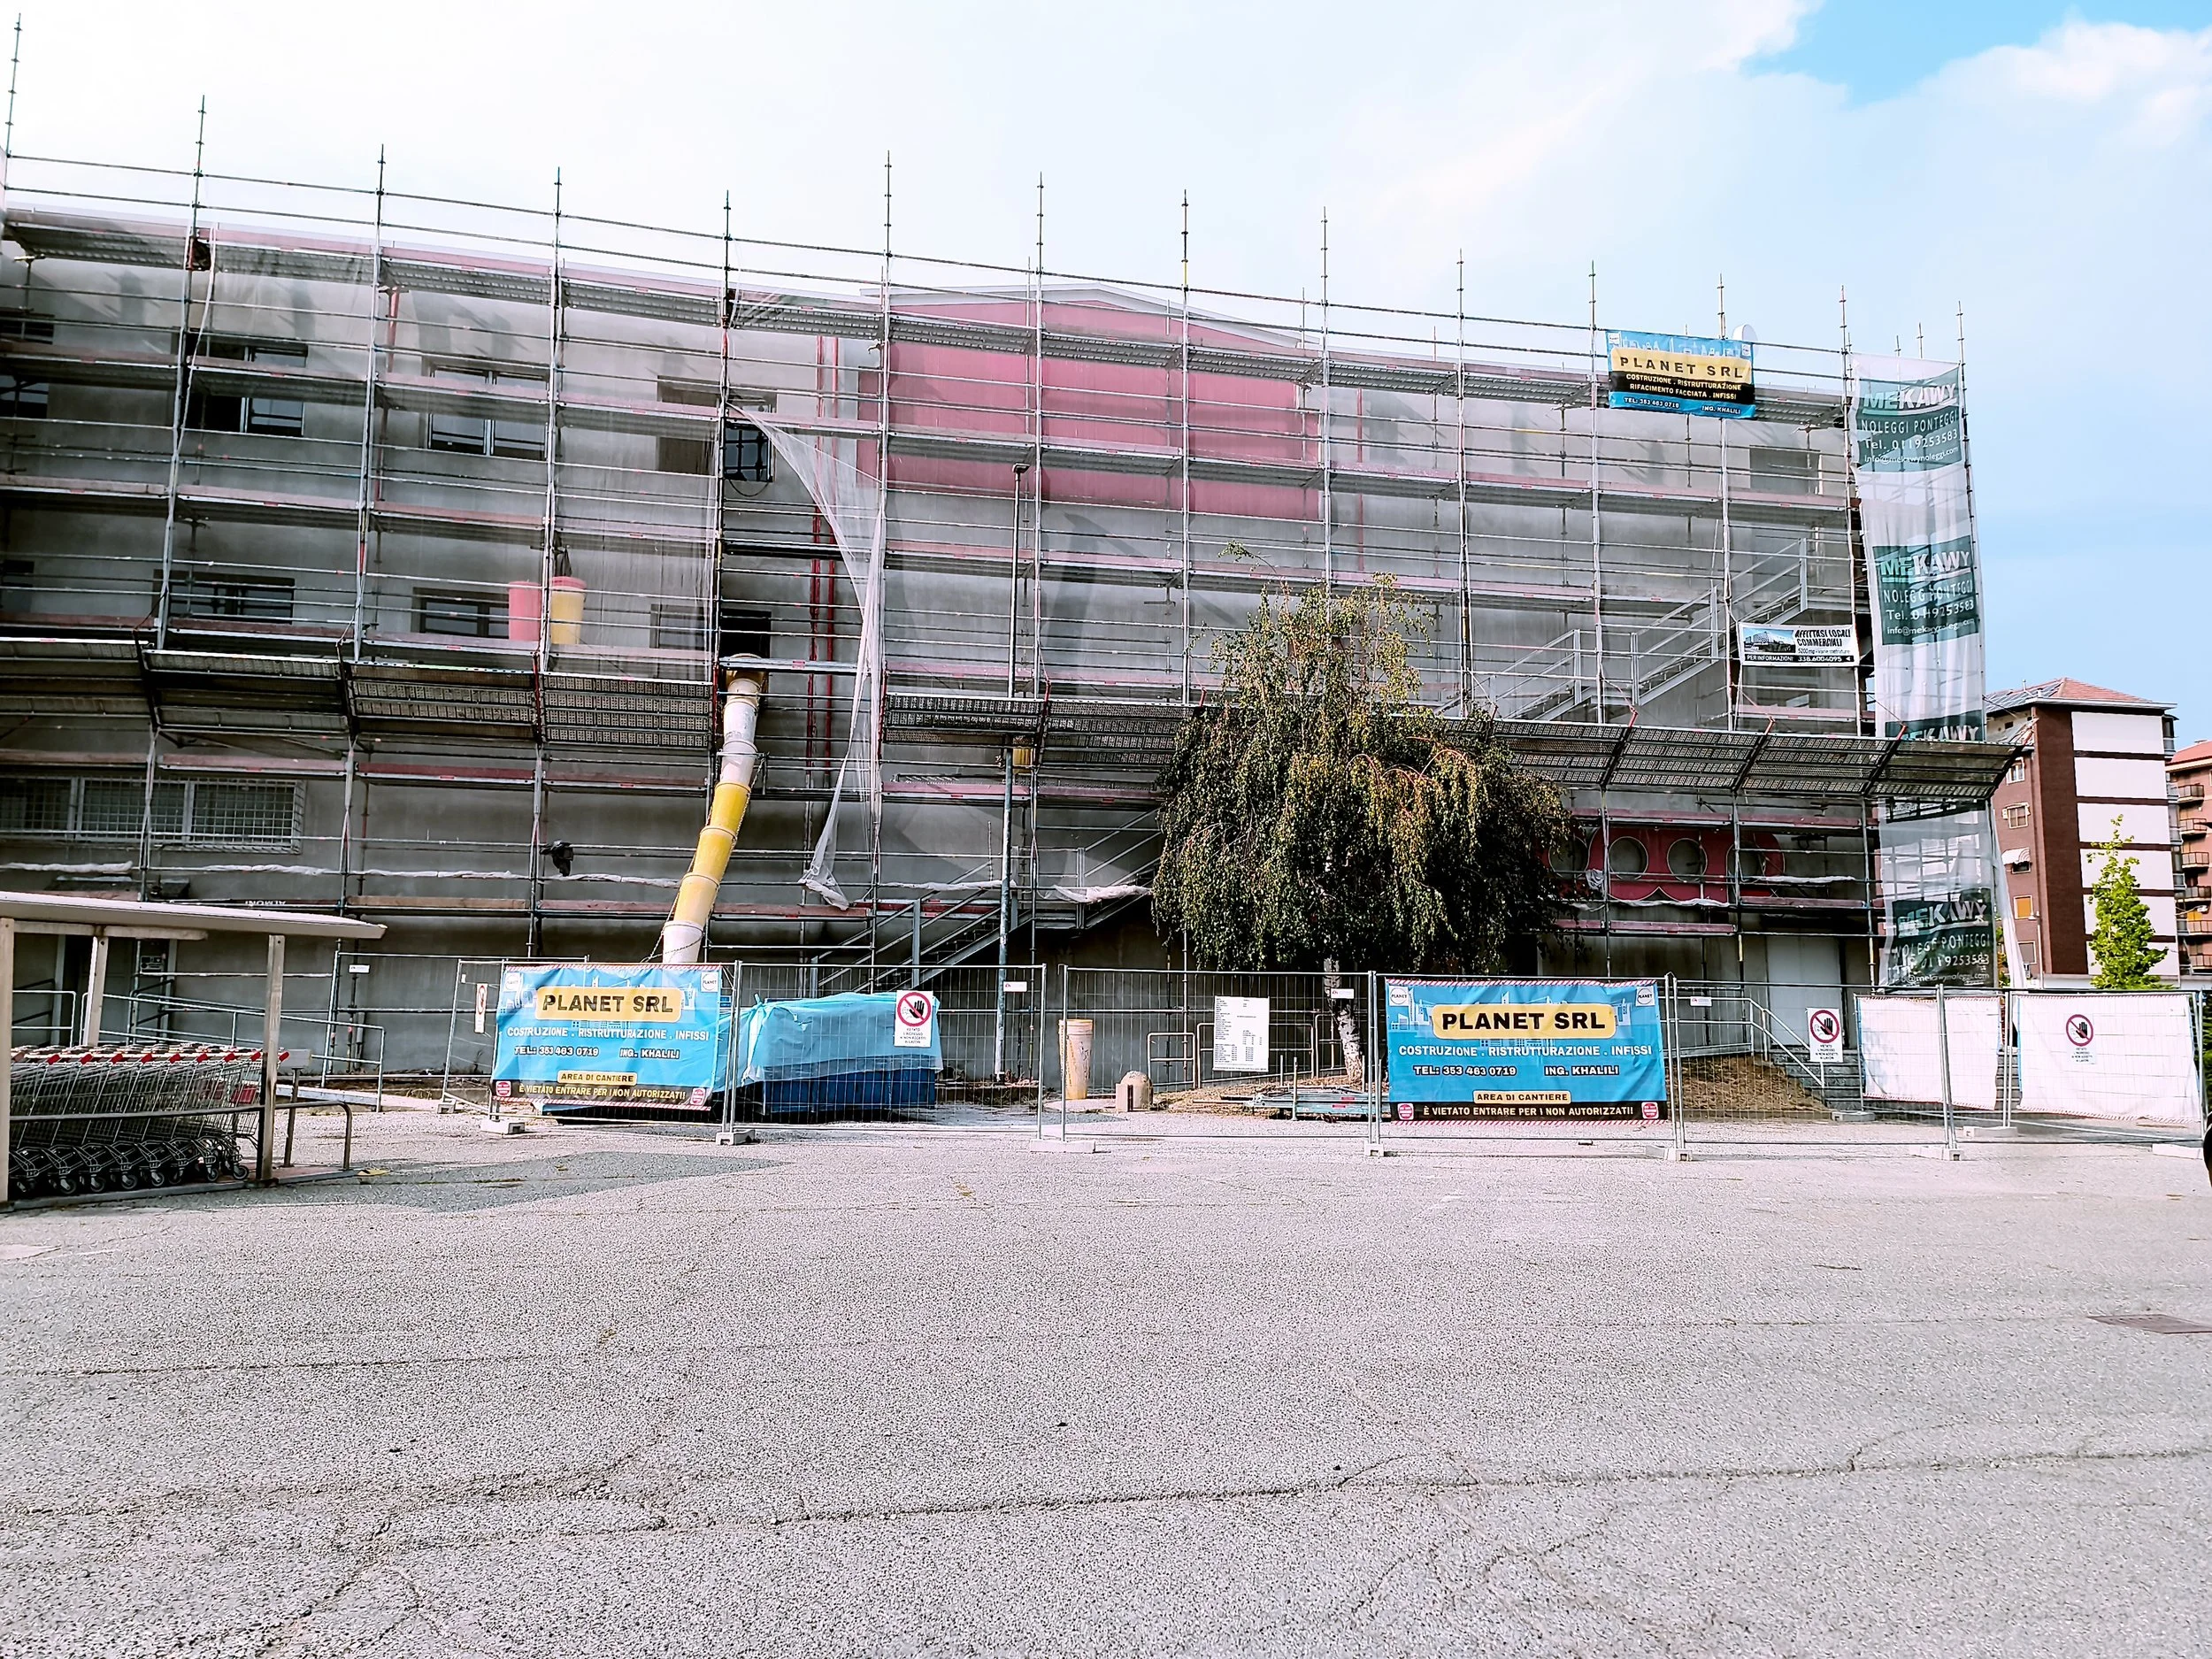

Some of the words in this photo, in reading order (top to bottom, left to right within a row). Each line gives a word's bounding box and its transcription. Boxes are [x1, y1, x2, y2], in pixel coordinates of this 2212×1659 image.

[1620, 357, 1695, 374] PLANET
[1707, 365, 1743, 379] SRL
[1626, 373, 1672, 385] COSTRUZIONE
[1677, 380, 1742, 391] RISTRUTTURAZIONE
[1630, 383, 1674, 395] RIFACIMENTO
[1675, 388, 1708, 398] FACCIATA
[1861, 419, 1909, 434] NOLEGGI
[1914, 410, 1958, 433] PONTEGGI
[1864, 440, 1886, 450] Tel.
[1886, 609, 1908, 620] Tel.
[542, 995, 624, 1012] PLANET
[633, 995, 673, 1013] SRL
[1442, 1012, 1545, 1030] PLANET
[1554, 1012, 1606, 1030] SRL
[507, 1026, 568, 1037] COSTRUZIONE
[578, 1028, 667, 1040] RISTRUTTURAZIONE
[675, 1031, 710, 1041] INFISSI
[514, 1046, 537, 1056] TEL:
[576, 1047, 599, 1056] 0719
[641, 1048, 680, 1060] KHALILI
[1398, 1046, 1478, 1056] COSTRUZIONE
[1488, 1046, 1601, 1057] RISTRUTTURAZIONE
[1611, 1045, 1653, 1056] INFISSI
[1413, 1065, 1440, 1076] TEL:
[1442, 1065, 1463, 1076] 353
[1465, 1066, 1486, 1076] 463
[1489, 1066, 1517, 1077] 0719
[1544, 1066, 1569, 1076] ING.
[1571, 1065, 1620, 1076] KHALILI
[595, 1074, 634, 1083] CANTIERE
[526, 1085, 554, 1094] VIETATO
[555, 1087, 591, 1096] ENTRARE
[1423, 1105, 1430, 1116] È
[1432, 1107, 1471, 1117] VIETATO
[1472, 1107, 1516, 1116] ENTRARE
[1568, 1106, 1634, 1116] AUTORIZZATI!
